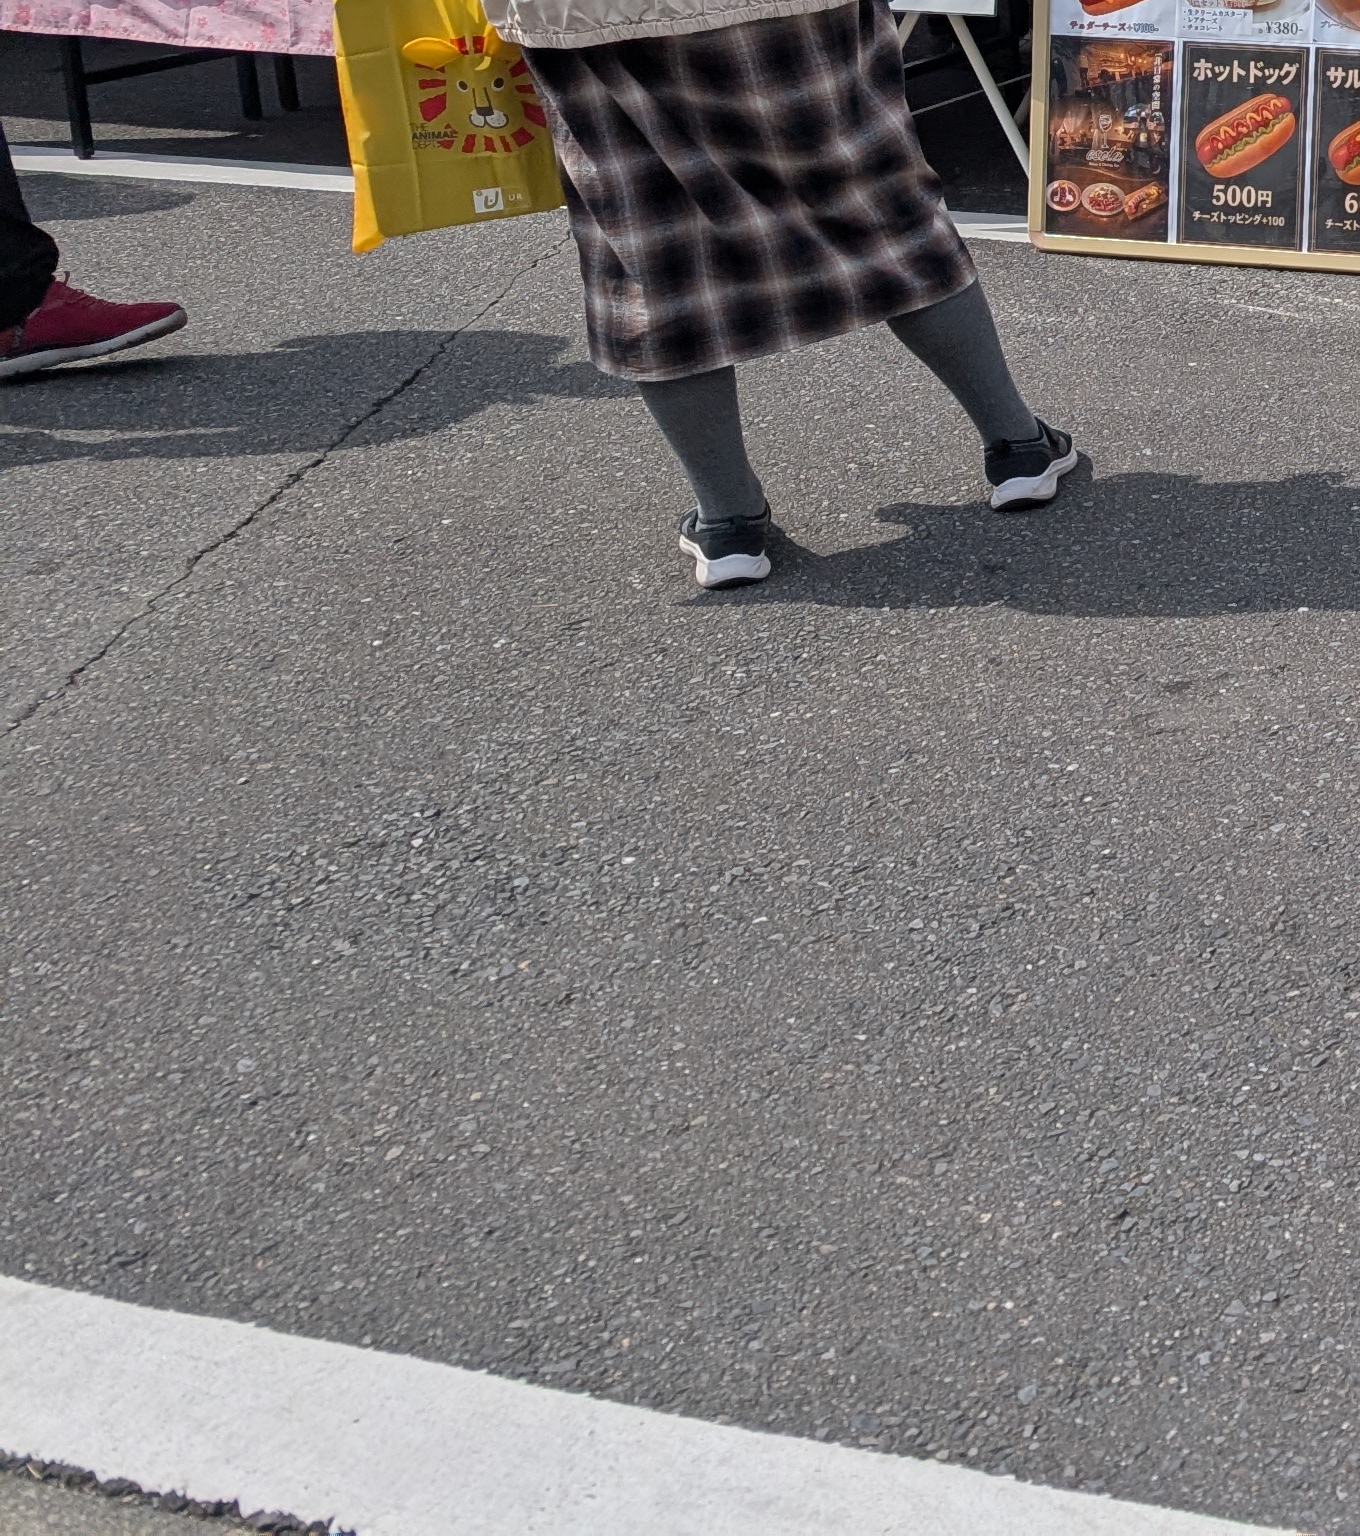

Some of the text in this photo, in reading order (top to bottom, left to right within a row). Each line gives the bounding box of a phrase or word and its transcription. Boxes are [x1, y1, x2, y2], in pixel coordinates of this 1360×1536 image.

[1192, 57, 1299, 86] ホットドッグ
[412, 130, 458, 141] ANIMAL
[508, 193, 523, 202] UR
[1211, 184, 1273, 208] 500円
[1192, 211, 1286, 227] チーズトッピング+100
